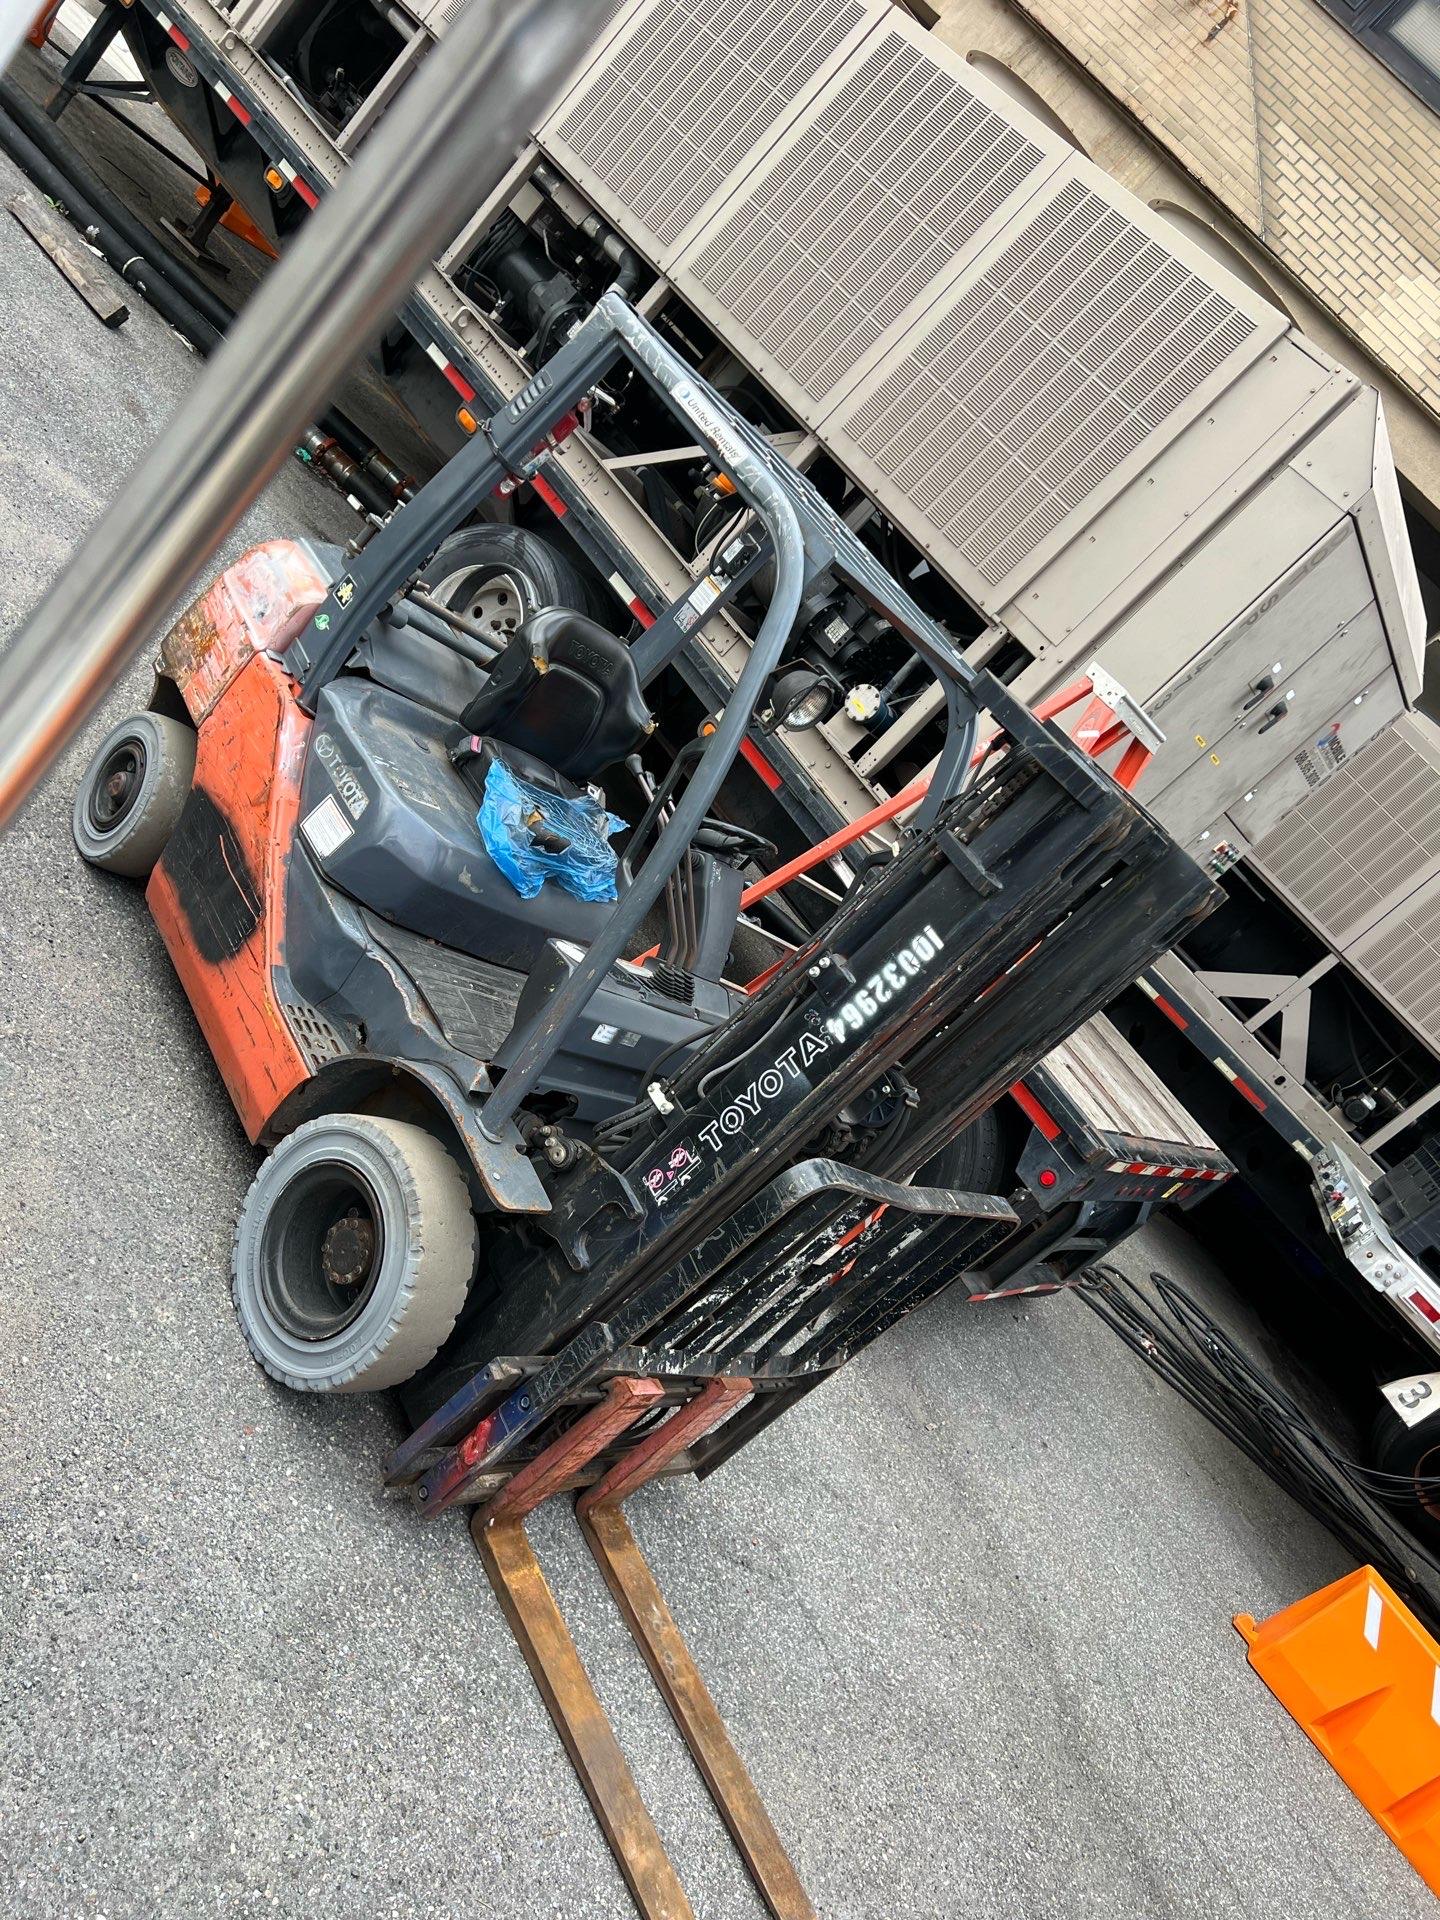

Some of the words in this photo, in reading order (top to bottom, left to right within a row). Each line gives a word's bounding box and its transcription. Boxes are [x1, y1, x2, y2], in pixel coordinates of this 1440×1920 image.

[686, 398, 712, 427] United
[710, 426, 739, 459] Rentals
[568, 639, 616, 680] TOYOTA
[1327, 735, 1346, 764] MOBILE
[329, 753, 369, 820] TOYOTA
[826, 924, 946, 1045] 10032964
[698, 1031, 829, 1153] TOYOTA
[1397, 1380, 1433, 1409] 3
